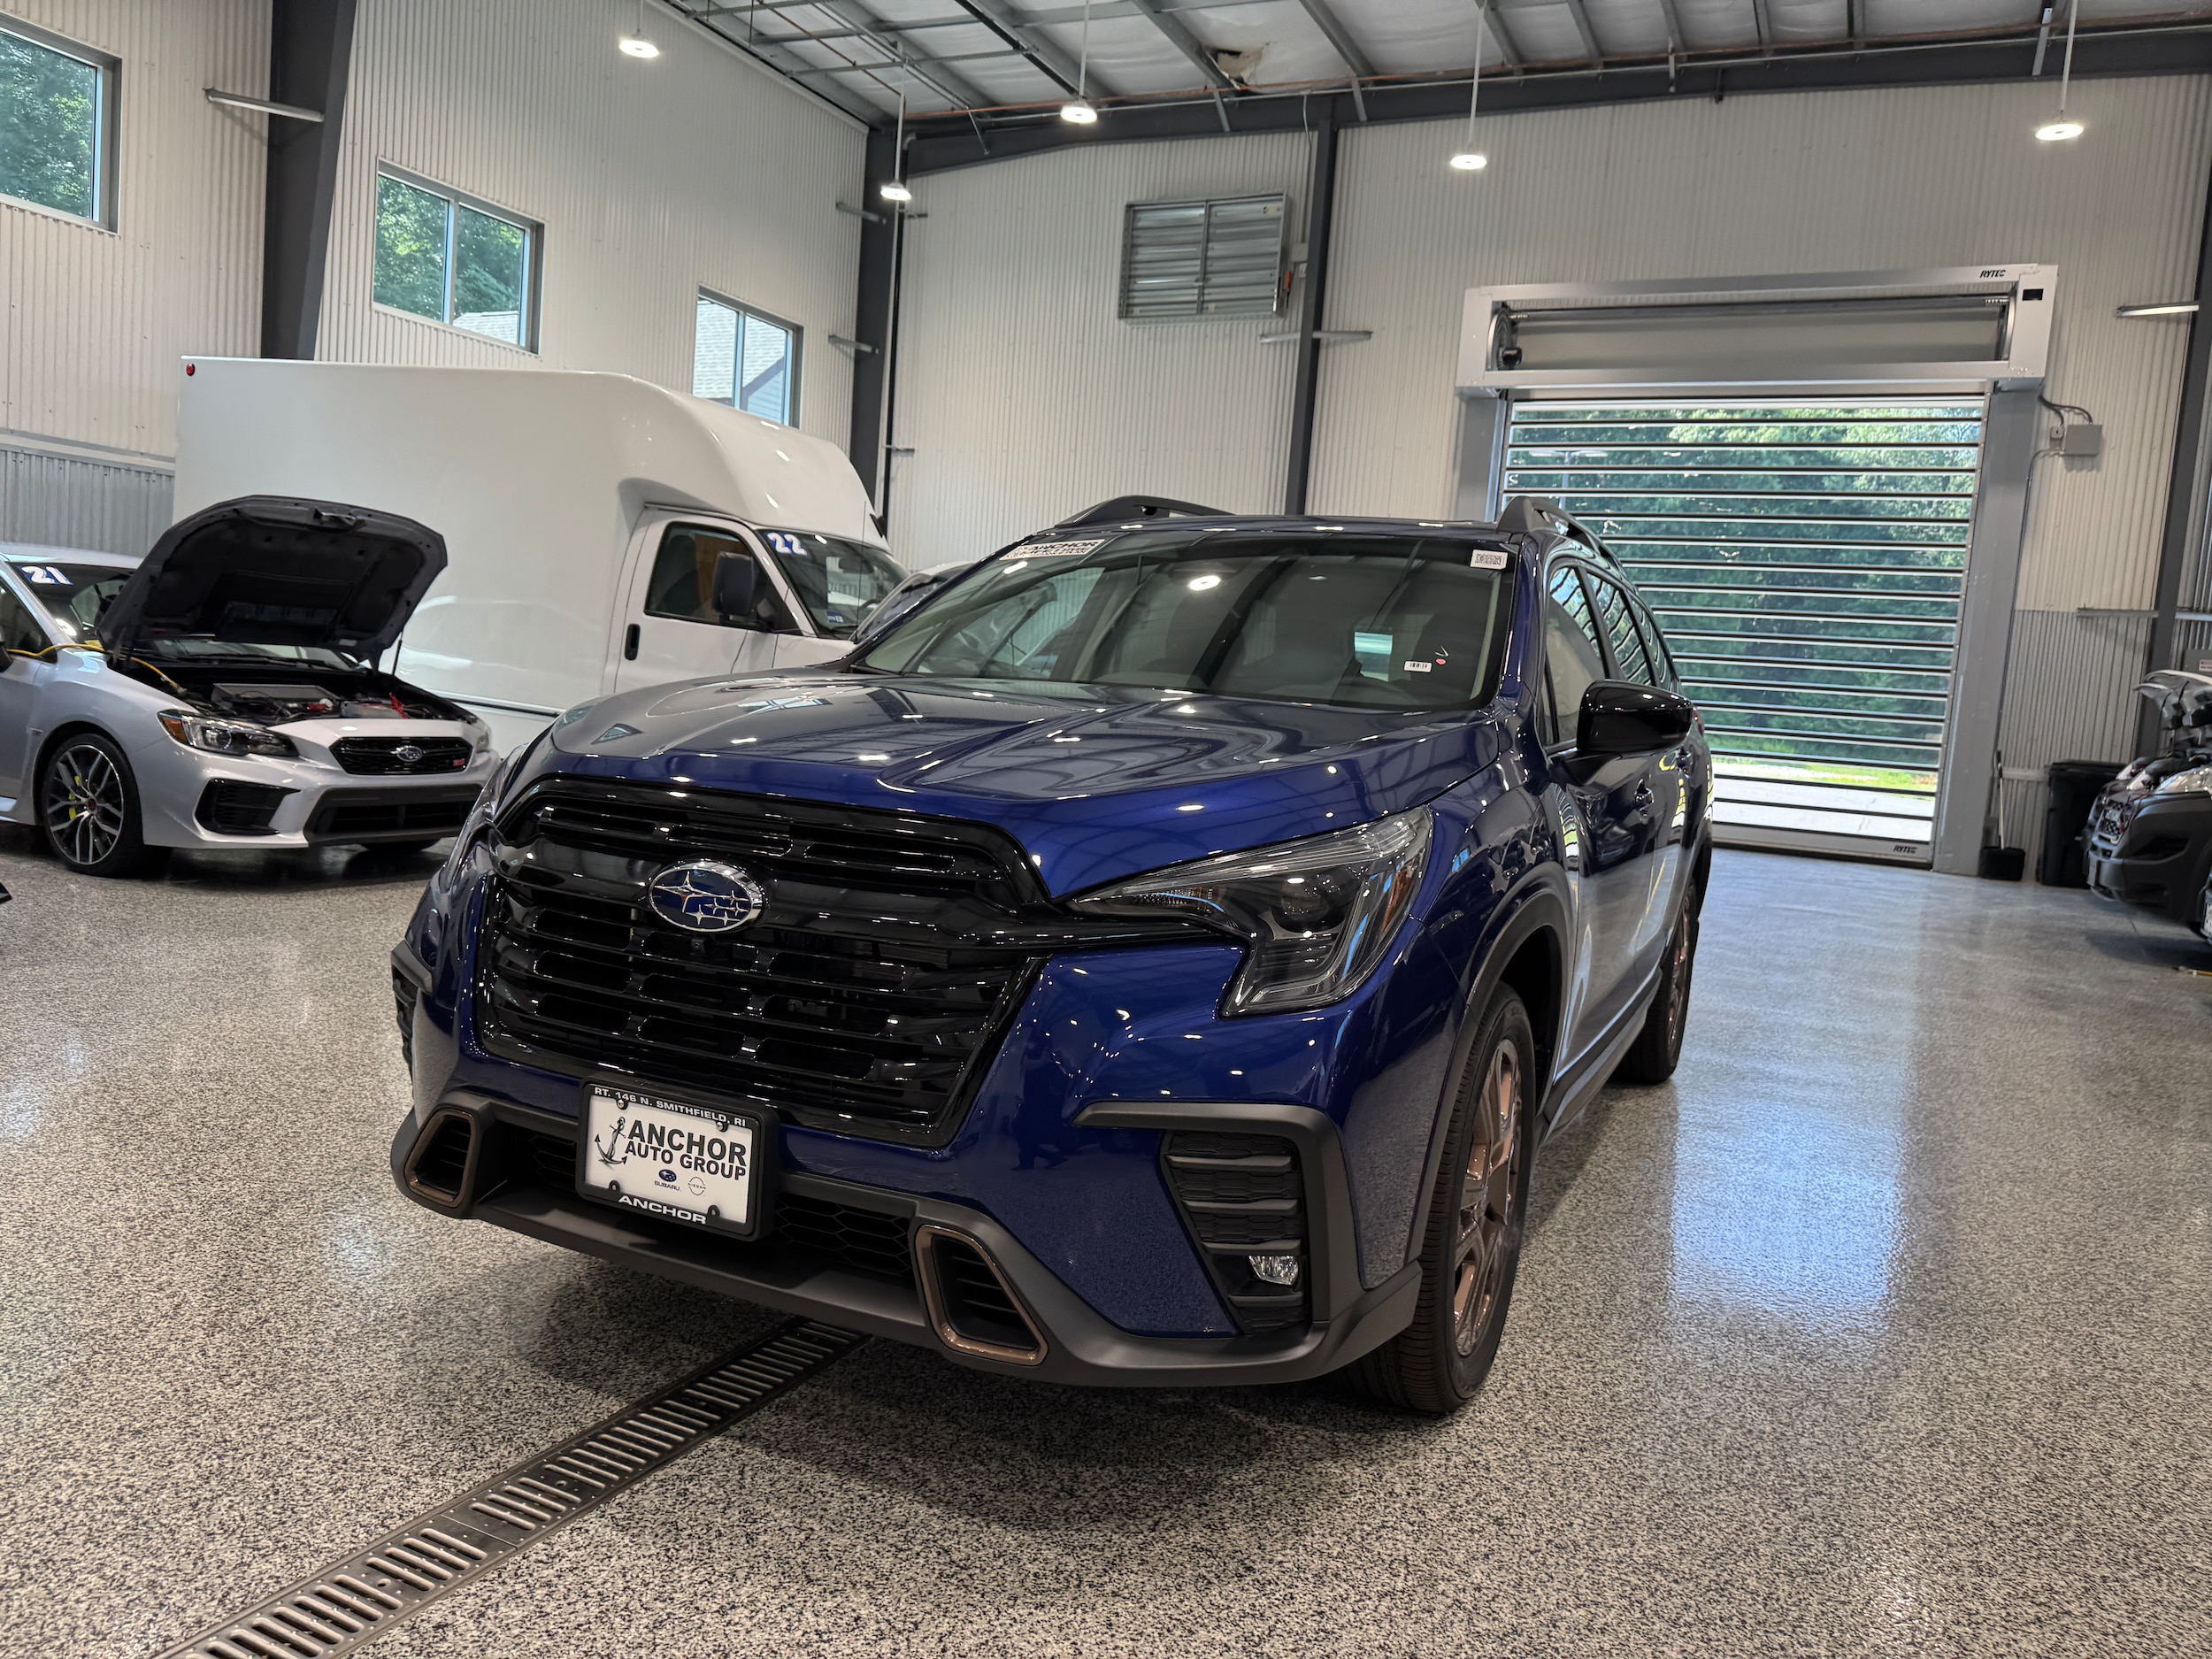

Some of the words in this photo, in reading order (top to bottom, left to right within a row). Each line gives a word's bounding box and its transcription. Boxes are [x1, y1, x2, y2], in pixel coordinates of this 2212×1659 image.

[1979, 269, 2006, 279] RYTEC
[766, 532, 808, 556] 22
[21, 565, 72, 585] 21
[594, 1087, 611, 1097] RT.
[615, 1091, 637, 1102] 146
[639, 1096, 653, 1106] N.
[656, 1100, 730, 1125] SMITHFIELD,
[734, 1118, 746, 1127] RI
[627, 1119, 747, 1167] ANCHOR
[625, 1141, 673, 1164] AUTO
[680, 1153, 747, 1181] GROUP
[654, 1180, 680, 1192] SUBARU
[618, 1194, 707, 1225] ANCHOR
